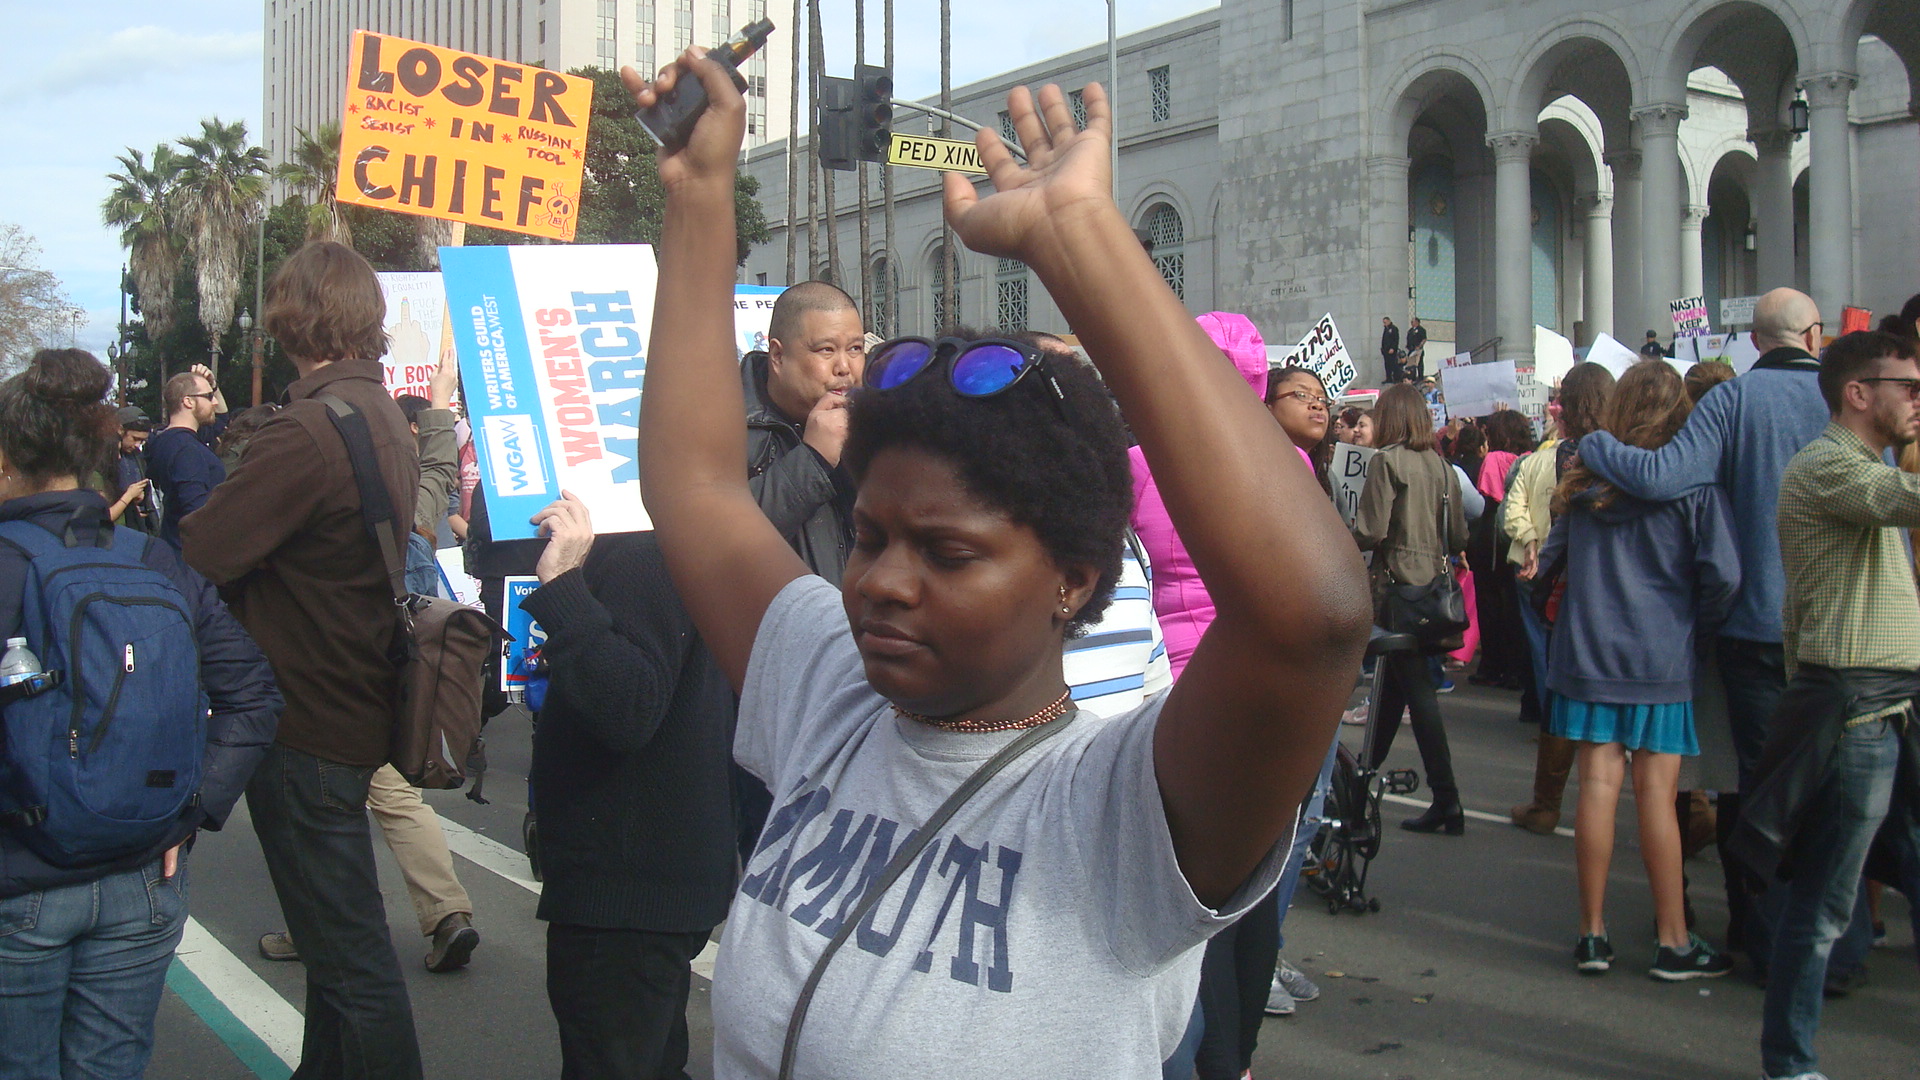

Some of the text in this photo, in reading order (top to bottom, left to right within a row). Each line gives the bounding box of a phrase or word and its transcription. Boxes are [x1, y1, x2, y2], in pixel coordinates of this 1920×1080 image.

[358, 33, 577, 128] LOSER
[365, 95, 424, 117] RACIST
[360, 115, 415, 135] SEXIST
[450, 117, 494, 143] IN
[518, 126, 572, 150] RUSSIAN
[526, 147, 566, 166] TOOL
[898, 140, 937, 162] PED
[353, 144, 545, 227] CHIEF
[1670, 296, 1703, 312] NASTY
[1672, 307, 1708, 322] WOMEN
[1679, 318, 1703, 330] KEEP
[471, 305, 503, 411] WRITERS GUILD
[405, 364, 439, 385] BOD
[1327, 364, 1354, 398] nds
[535, 308, 603, 467] WOMEN'S
[571, 290, 646, 484] MARCH
[1518, 387, 1536, 398] NOT
[504, 392, 518, 409] OF
[498, 419, 529, 492] WGAW
